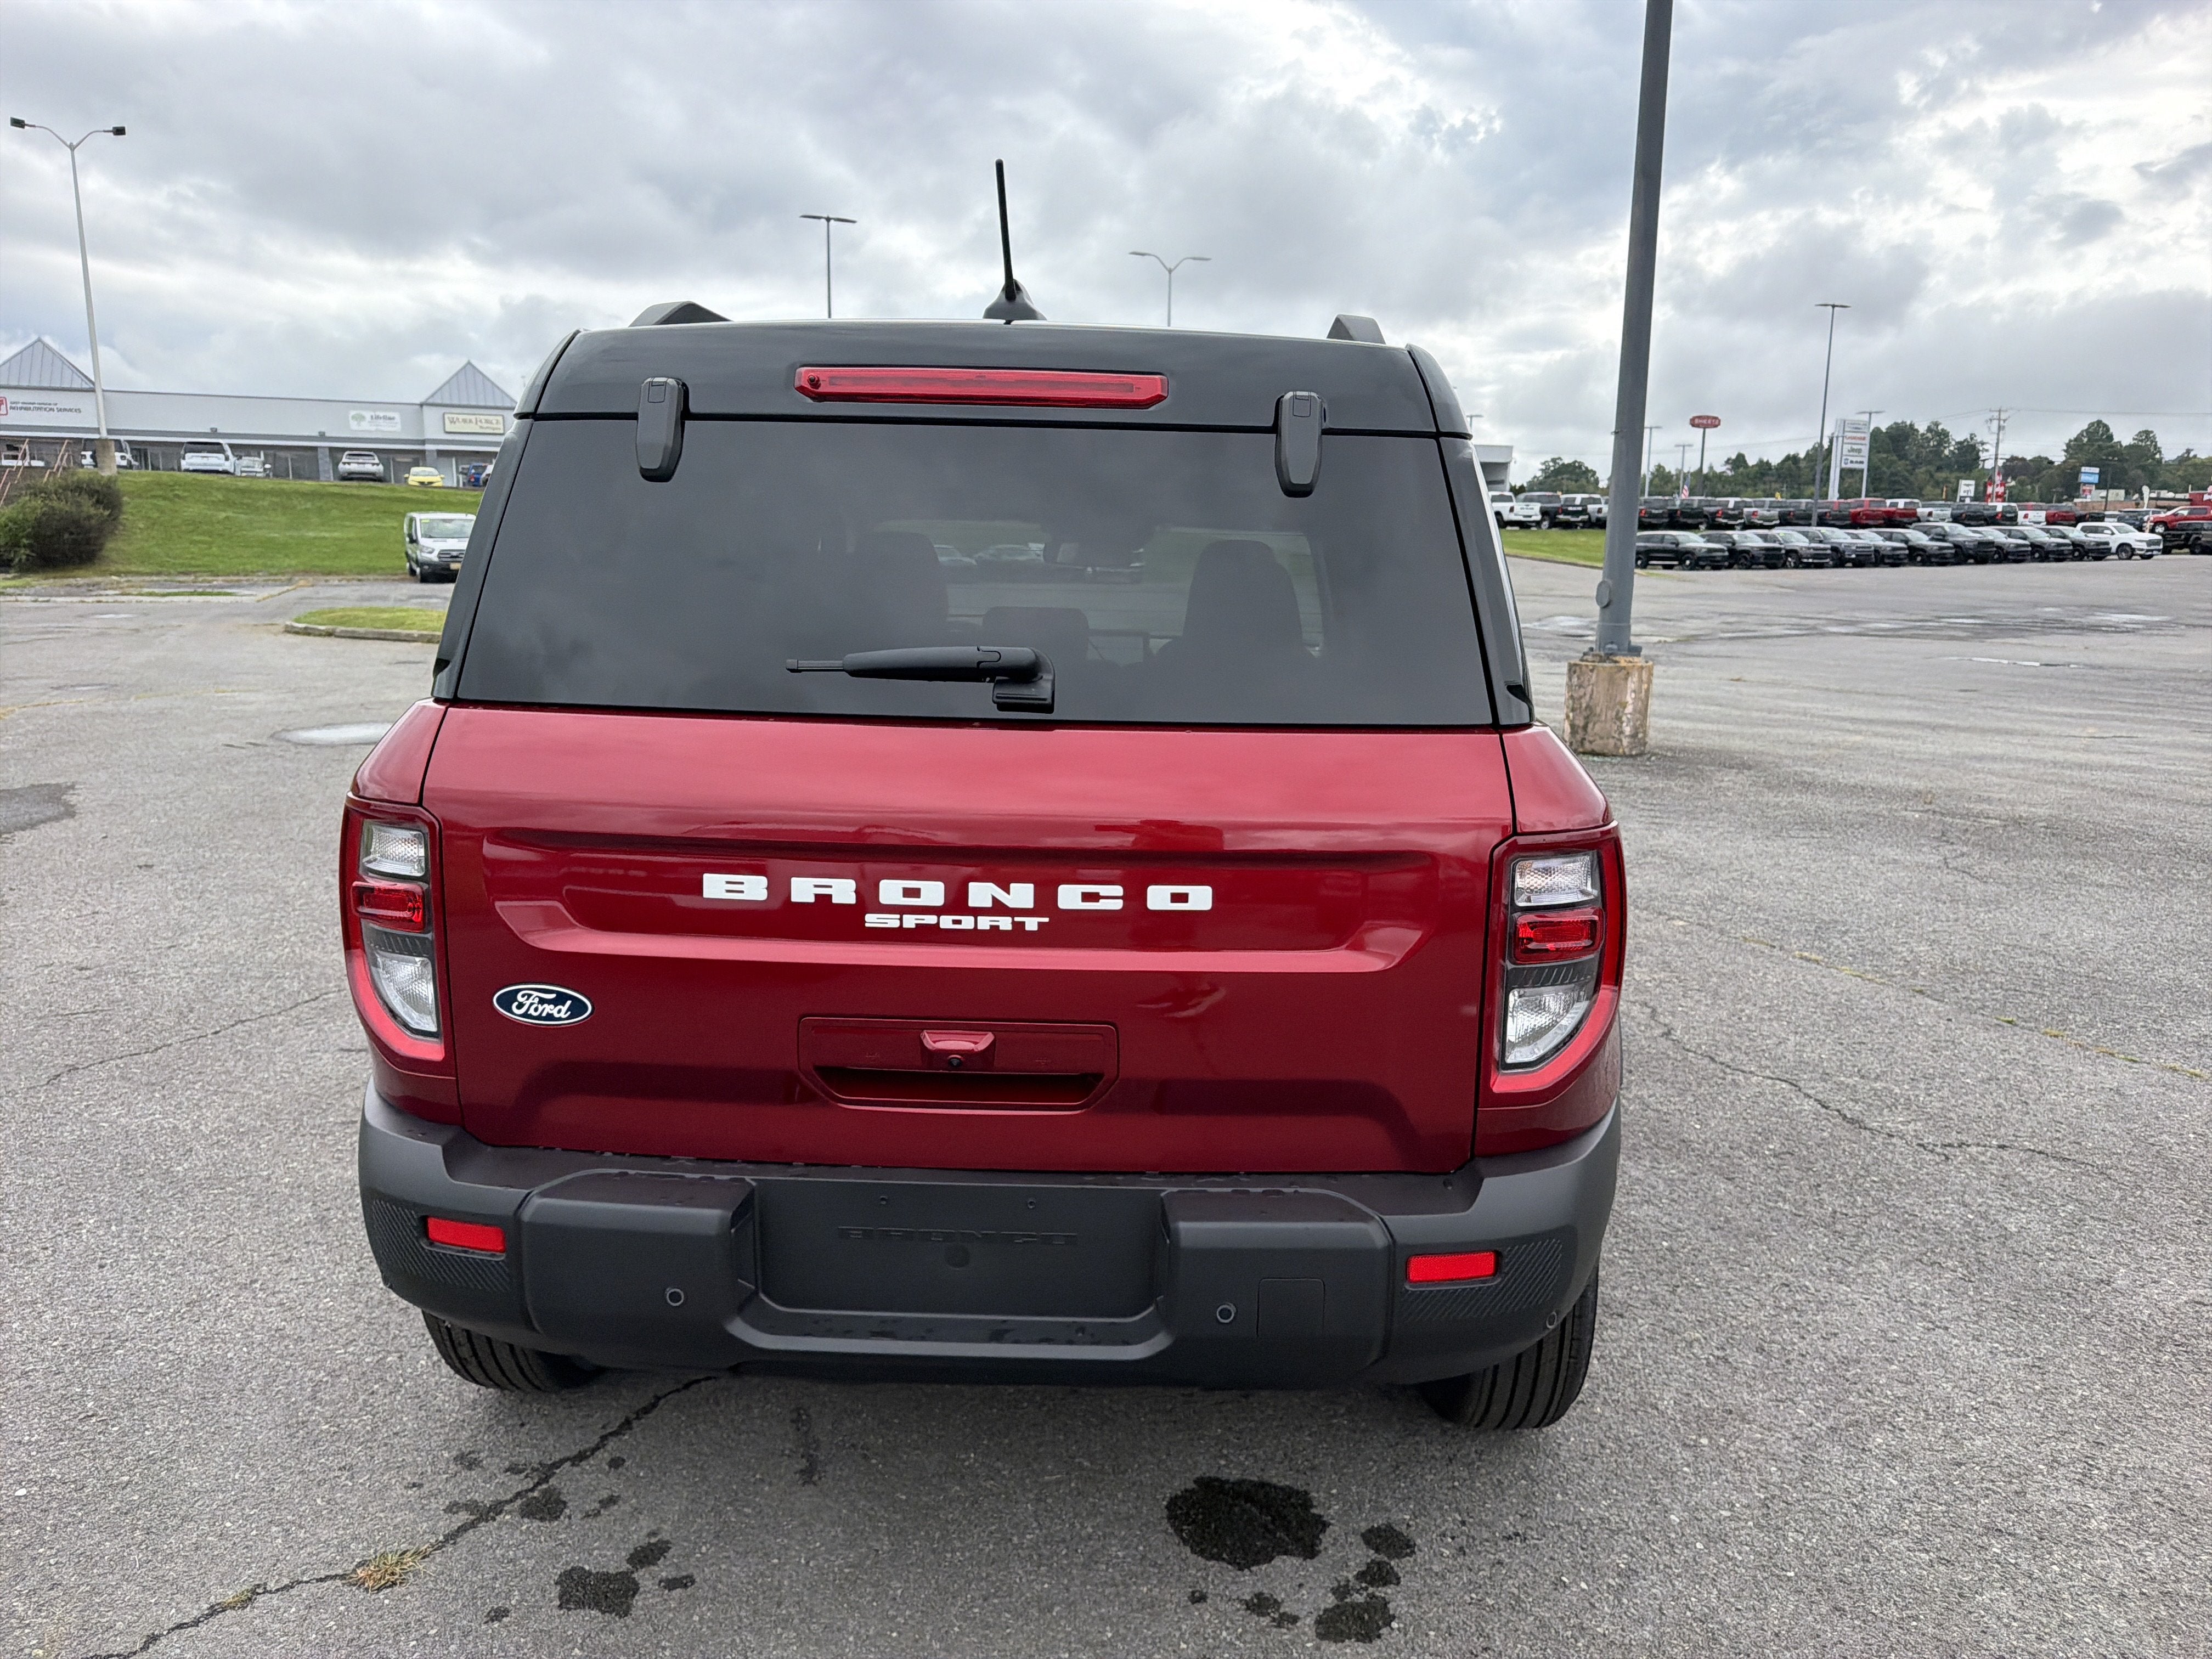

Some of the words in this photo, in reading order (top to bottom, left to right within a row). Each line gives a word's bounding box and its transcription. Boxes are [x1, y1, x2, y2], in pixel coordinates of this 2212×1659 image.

[702, 873, 1213, 911] BRONCO
[864, 913, 1050, 931] SPORT
[512, 990, 572, 1018] Ford
